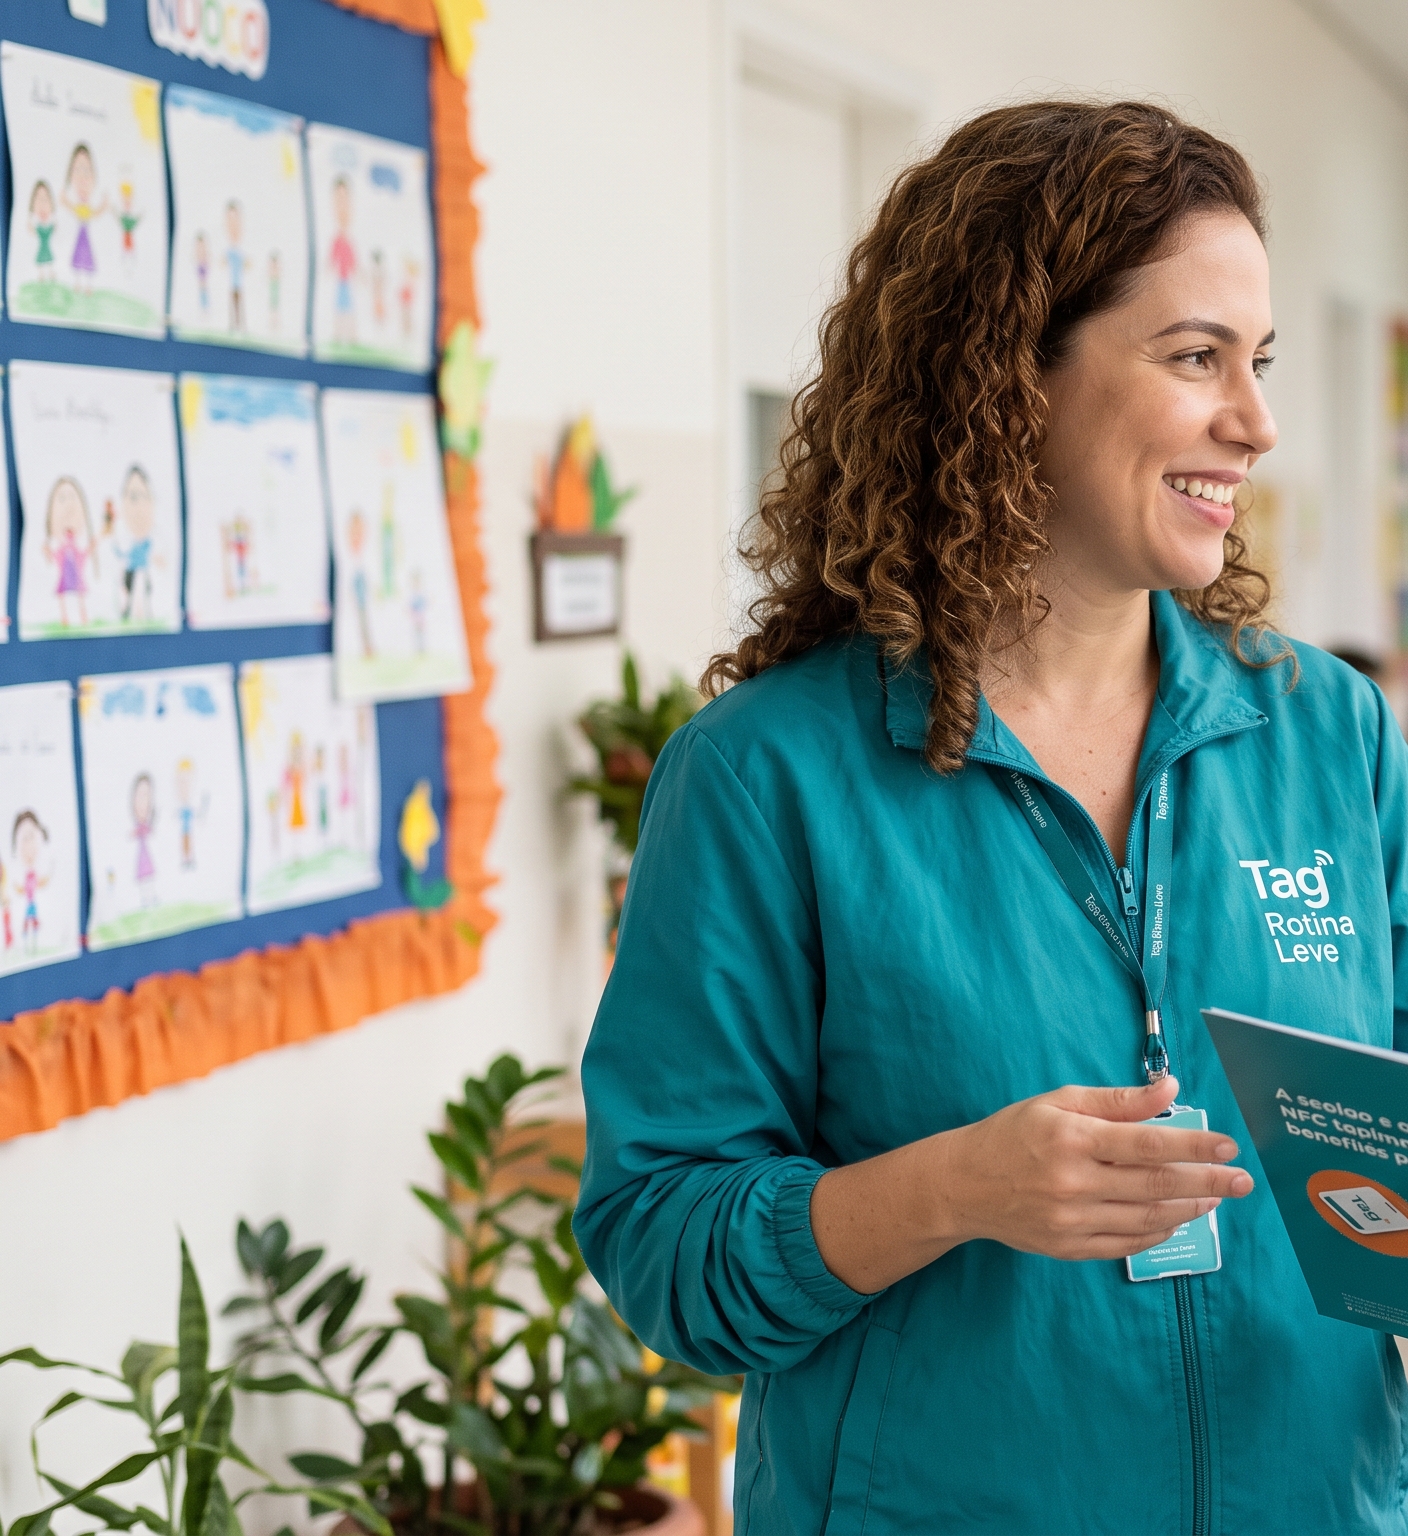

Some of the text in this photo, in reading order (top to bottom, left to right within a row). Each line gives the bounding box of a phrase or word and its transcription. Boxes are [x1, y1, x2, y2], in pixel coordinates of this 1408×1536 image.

[1239, 860, 1330, 909] Tag
[1264, 912, 1356, 936] Rotina
[1274, 939, 1339, 963] Leve
[1275, 1087, 1293, 1102] A
[1378, 1116, 1393, 1128] e
[1280, 1105, 1328, 1127] NFC
[1351, 1194, 1383, 1222] Tag
